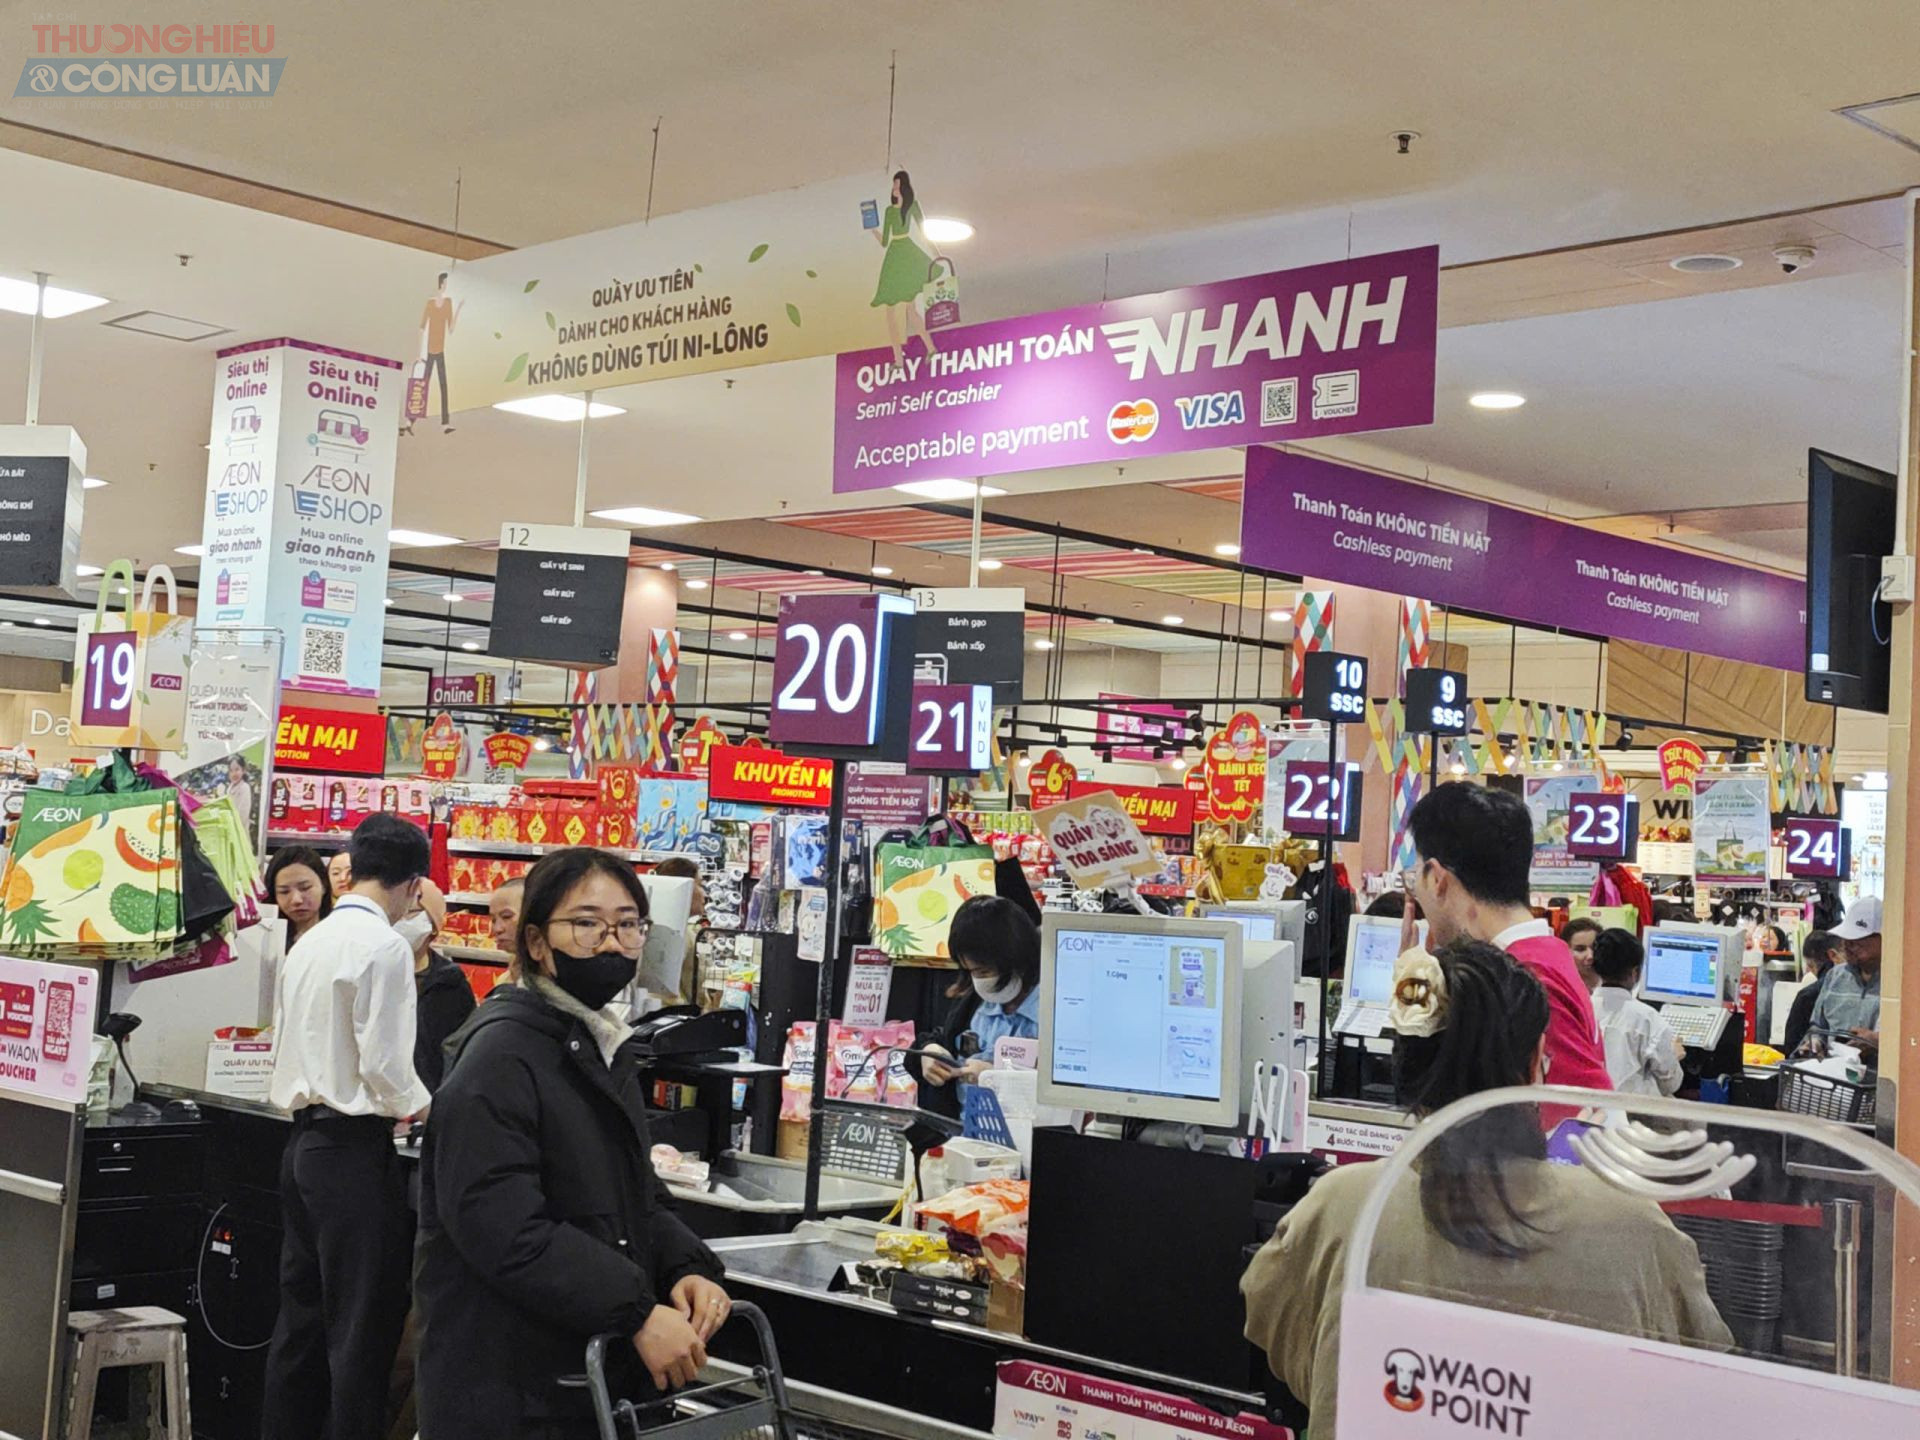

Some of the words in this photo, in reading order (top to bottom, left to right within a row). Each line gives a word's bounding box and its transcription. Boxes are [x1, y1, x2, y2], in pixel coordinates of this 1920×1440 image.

[592, 278, 633, 307] QUẦY
[635, 279, 656, 299] ƯU
[659, 268, 694, 295] TIÊN
[558, 320, 597, 344] DÀNH
[600, 314, 629, 337] CHO
[632, 303, 683, 331] KHÁCH
[687, 295, 732, 322] HÀNG
[1100, 275, 1408, 381] NHANH
[528, 353, 588, 385] KHÔNG
[591, 343, 642, 375] DÙNG
[647, 334, 678, 365] TÚI
[682, 322, 768, 360] NI-LÔNG
[930, 341, 1013, 378] THANH
[1020, 324, 1094, 362] TOÁN
[253, 356, 269, 376] thị
[309, 360, 349, 382] Siêu
[354, 370, 380, 392] thị
[226, 381, 267, 400] Online
[307, 381, 377, 409] Online
[856, 396, 896, 420] Semi
[900, 390, 933, 413] Self
[935, 382, 1002, 408] Cashier
[1178, 391, 1243, 428] VISA
[854, 430, 976, 470] Acceptable
[982, 416, 1090, 458] payment
[300, 527, 326, 540] Mua
[329, 533, 364, 546] online
[508, 527, 530, 546] 12
[1293, 493, 1336, 517] Thanh
[1340, 503, 1372, 526] Toán
[1376, 511, 1426, 538] KHÔNG
[1463, 530, 1492, 555] MẶT
[231, 538, 262, 551] nhanh
[285, 539, 321, 554] giao
[325, 545, 375, 563] nhanh
[1333, 531, 1392, 558] Cashless
[1394, 547, 1453, 571] payment
[1576, 559, 1609, 581] Thanh
[1612, 567, 1637, 586] Toán
[1639, 573, 1678, 595] KHÔNG
[1707, 588, 1729, 609] MẶT
[917, 591, 936, 608] 13
[1607, 591, 1652, 614] Cashless
[1654, 604, 1700, 624] payment
[948, 618, 969, 627] Bánh
[947, 641, 968, 650] Bánh
[91, 642, 136, 710] 19
[777, 623, 868, 714] 20
[1336, 659, 1363, 689] 10
[433, 686, 474, 703] Online
[1331, 692, 1364, 714] SSC
[1441, 675, 1456, 703] 9
[31, 709, 71, 737] Da
[915, 701, 966, 753] 21
[1432, 706, 1465, 727] SSC
[312, 725, 358, 755] MẠI
[734, 760, 813, 786] KHUYẾN
[1218, 761, 1245, 776] BÁNH
[771, 787, 815, 798] PROMOTION
[847, 795, 879, 806] KHÔNG
[1287, 774, 1340, 820] 22
[1149, 801, 1177, 822] MẠI
[1653, 800, 1693, 819] WI
[1571, 804, 1620, 845] 23
[1101, 840, 1139, 862] SÁNG
[1788, 829, 1837, 866] 24
[855, 982, 872, 990] MUA
[8, 1043, 39, 1062] WAON
[0, 1062, 36, 1082] OUCHER
[1325, 1124, 1344, 1134] THAO
[1346, 1126, 1357, 1136] TÁC
[1327, 1133, 1335, 1146] 4
[1356, 1141, 1380, 1150] THANH
[1429, 1354, 1531, 1404] WAON
[1081, 1384, 1114, 1400] THANH
[1116, 1390, 1142, 1407] TOÁN
[1144, 1398, 1178, 1417] THÔNG
[1179, 1409, 1206, 1424] MINH
[1208, 1416, 1224, 1430] TẠI
[1431, 1389, 1531, 1438] POINT
